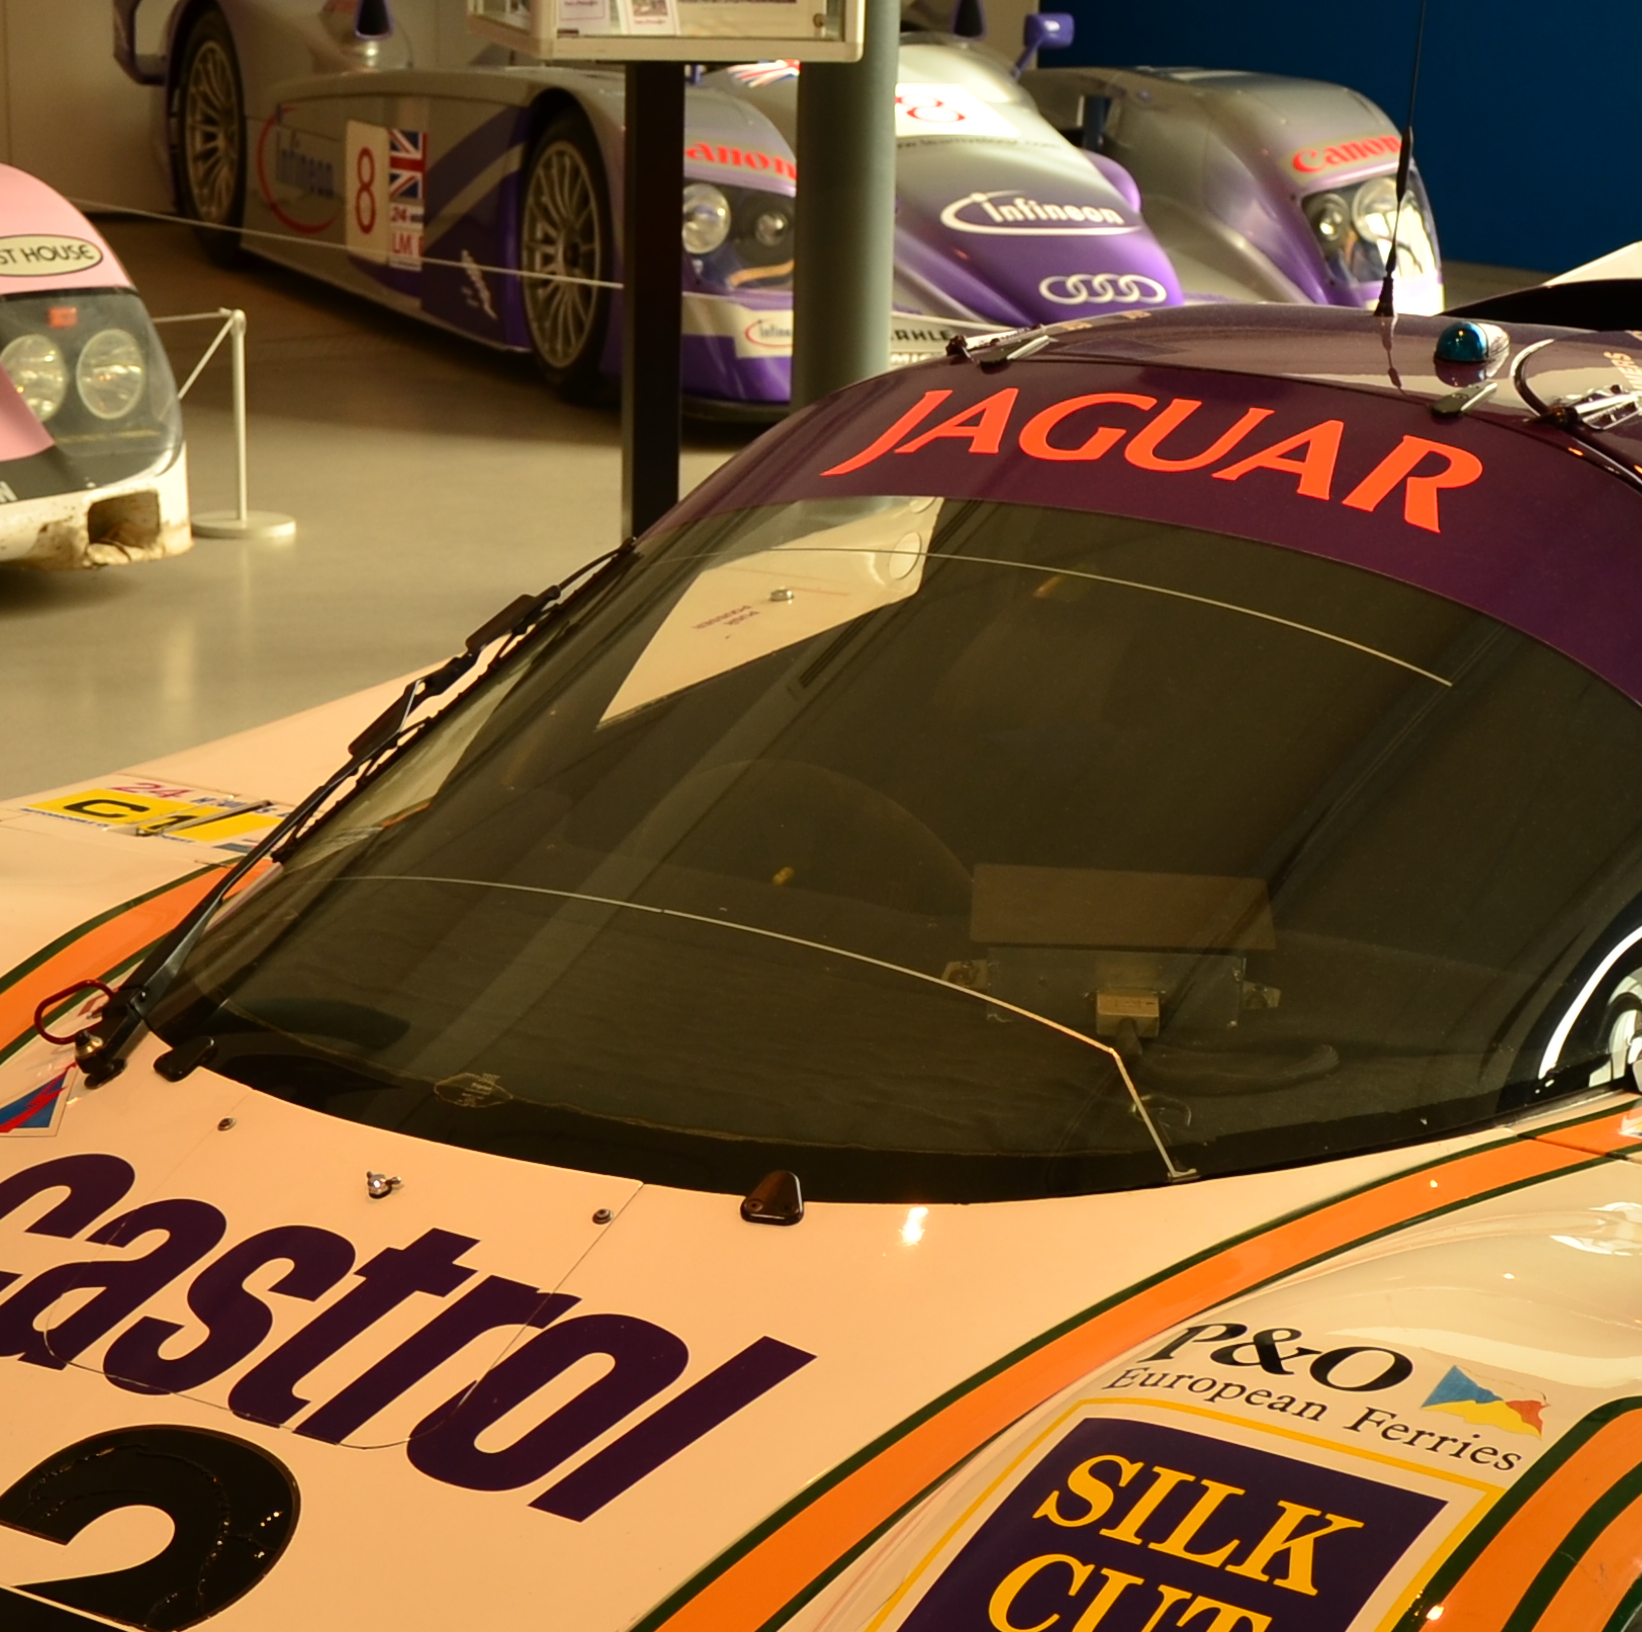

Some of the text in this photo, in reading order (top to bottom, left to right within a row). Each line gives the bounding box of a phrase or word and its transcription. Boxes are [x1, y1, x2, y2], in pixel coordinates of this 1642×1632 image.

[684, 141, 796, 180] anon
[1291, 134, 1402, 173] Canon
[355, 147, 376, 234] 8
[970, 192, 1125, 225] Infineon
[21, 244, 95, 263] HOUSE
[891, 329, 950, 341] AHLE
[820, 387, 1483, 533] JAGUAR
[1136, 1322, 1414, 1393] P&O
[1101, 1366, 1522, 1472] European Ferries
[1032, 1453, 1365, 1597] SILK
